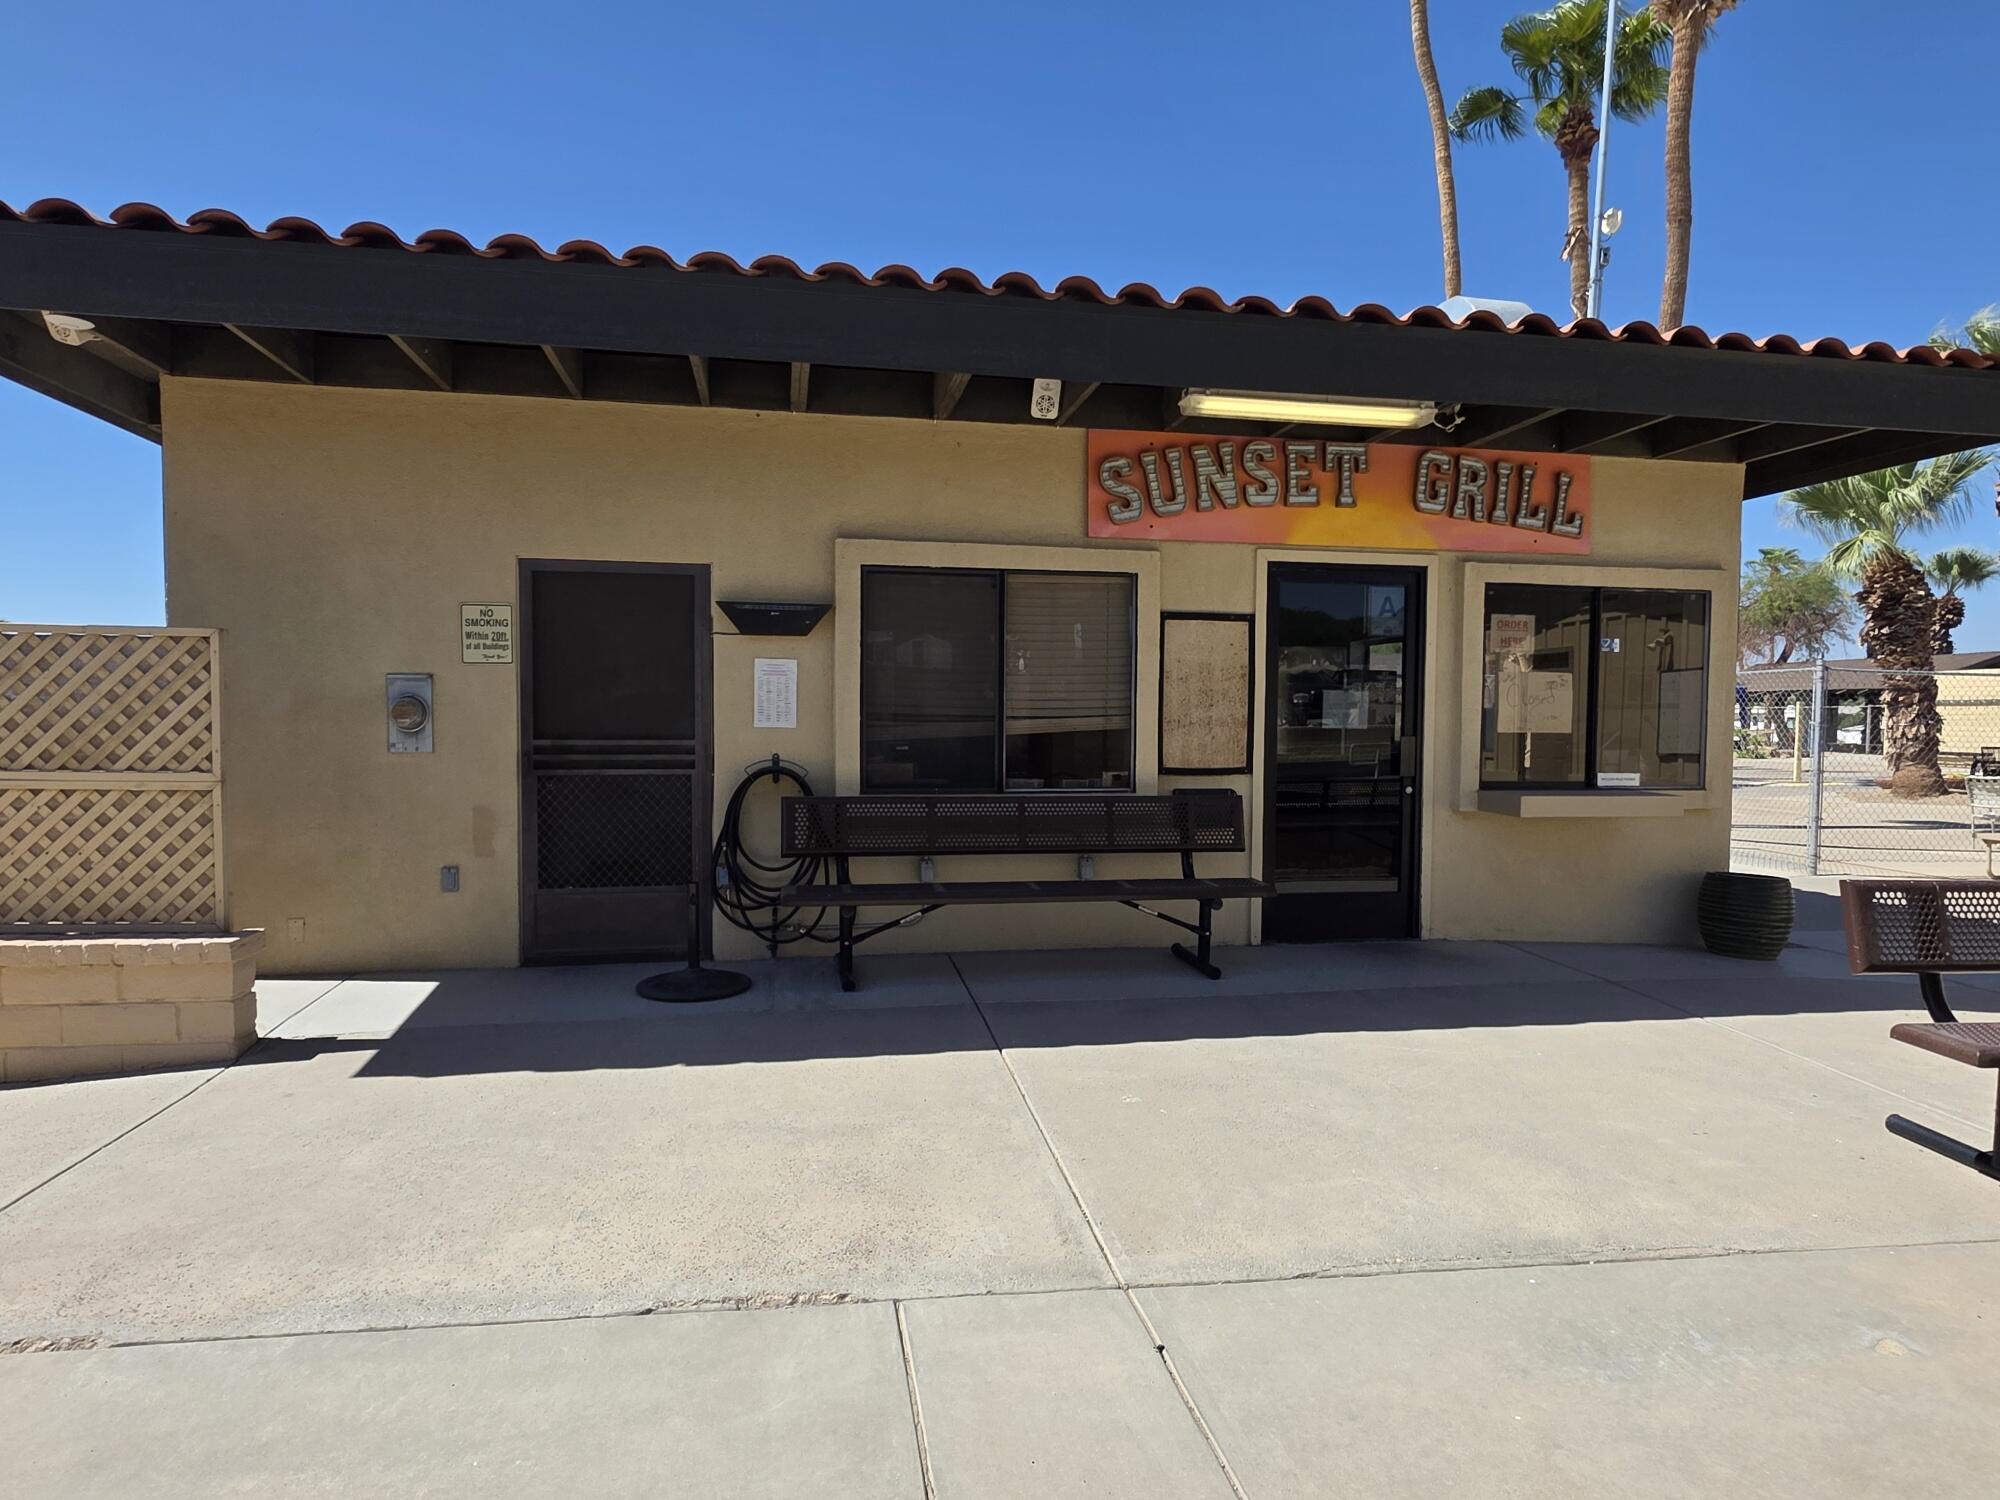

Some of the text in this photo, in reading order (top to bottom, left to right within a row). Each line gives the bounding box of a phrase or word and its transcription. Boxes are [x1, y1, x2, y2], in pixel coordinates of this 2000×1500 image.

[1099, 440, 1584, 539] SUNSET GRILL
[1378, 595, 1397, 617] A
[479, 608, 494, 618] NO
[464, 618, 509, 627] SMOKING
[1496, 620, 1529, 631] ORDER
[465, 631, 489, 641] Within
[466, 642, 472, 650] of
